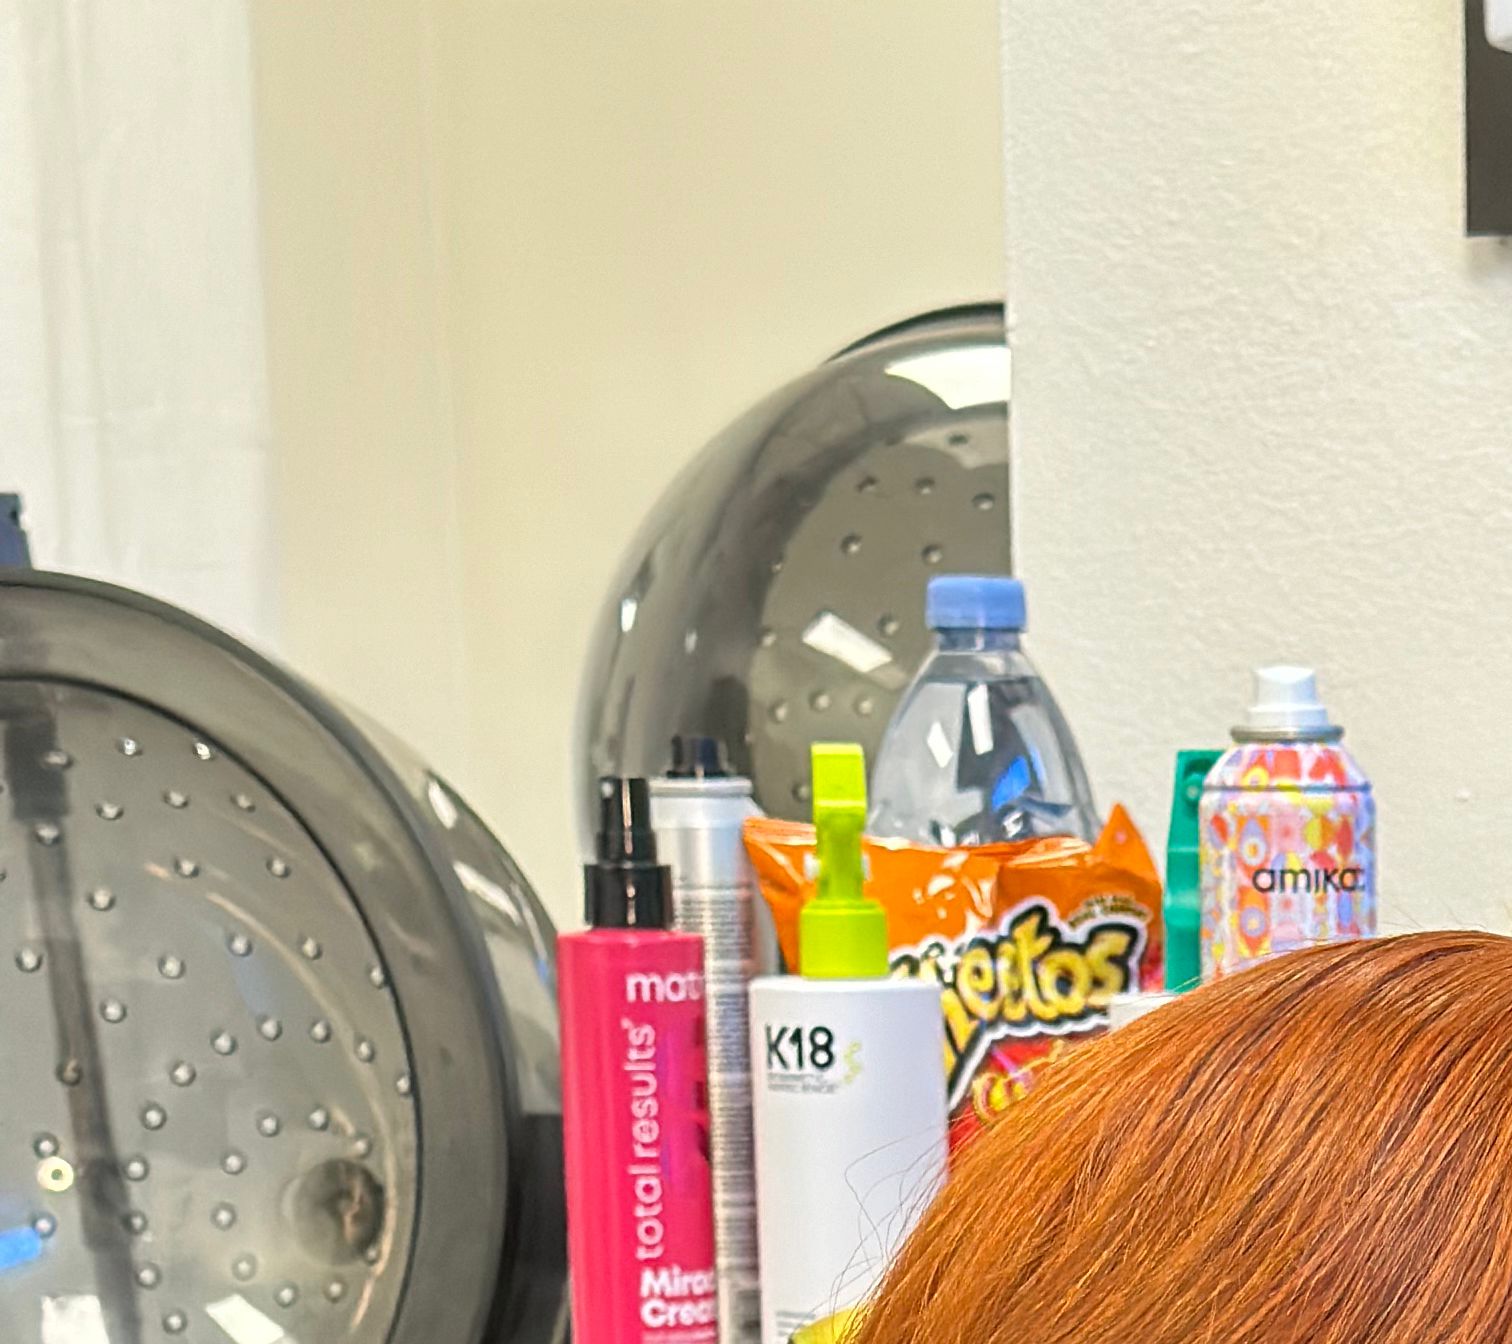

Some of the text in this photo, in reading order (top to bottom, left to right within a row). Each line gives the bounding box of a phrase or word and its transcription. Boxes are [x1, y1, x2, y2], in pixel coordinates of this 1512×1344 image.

[765, 1025, 836, 1069] K18
[623, 1023, 664, 1260] total results
